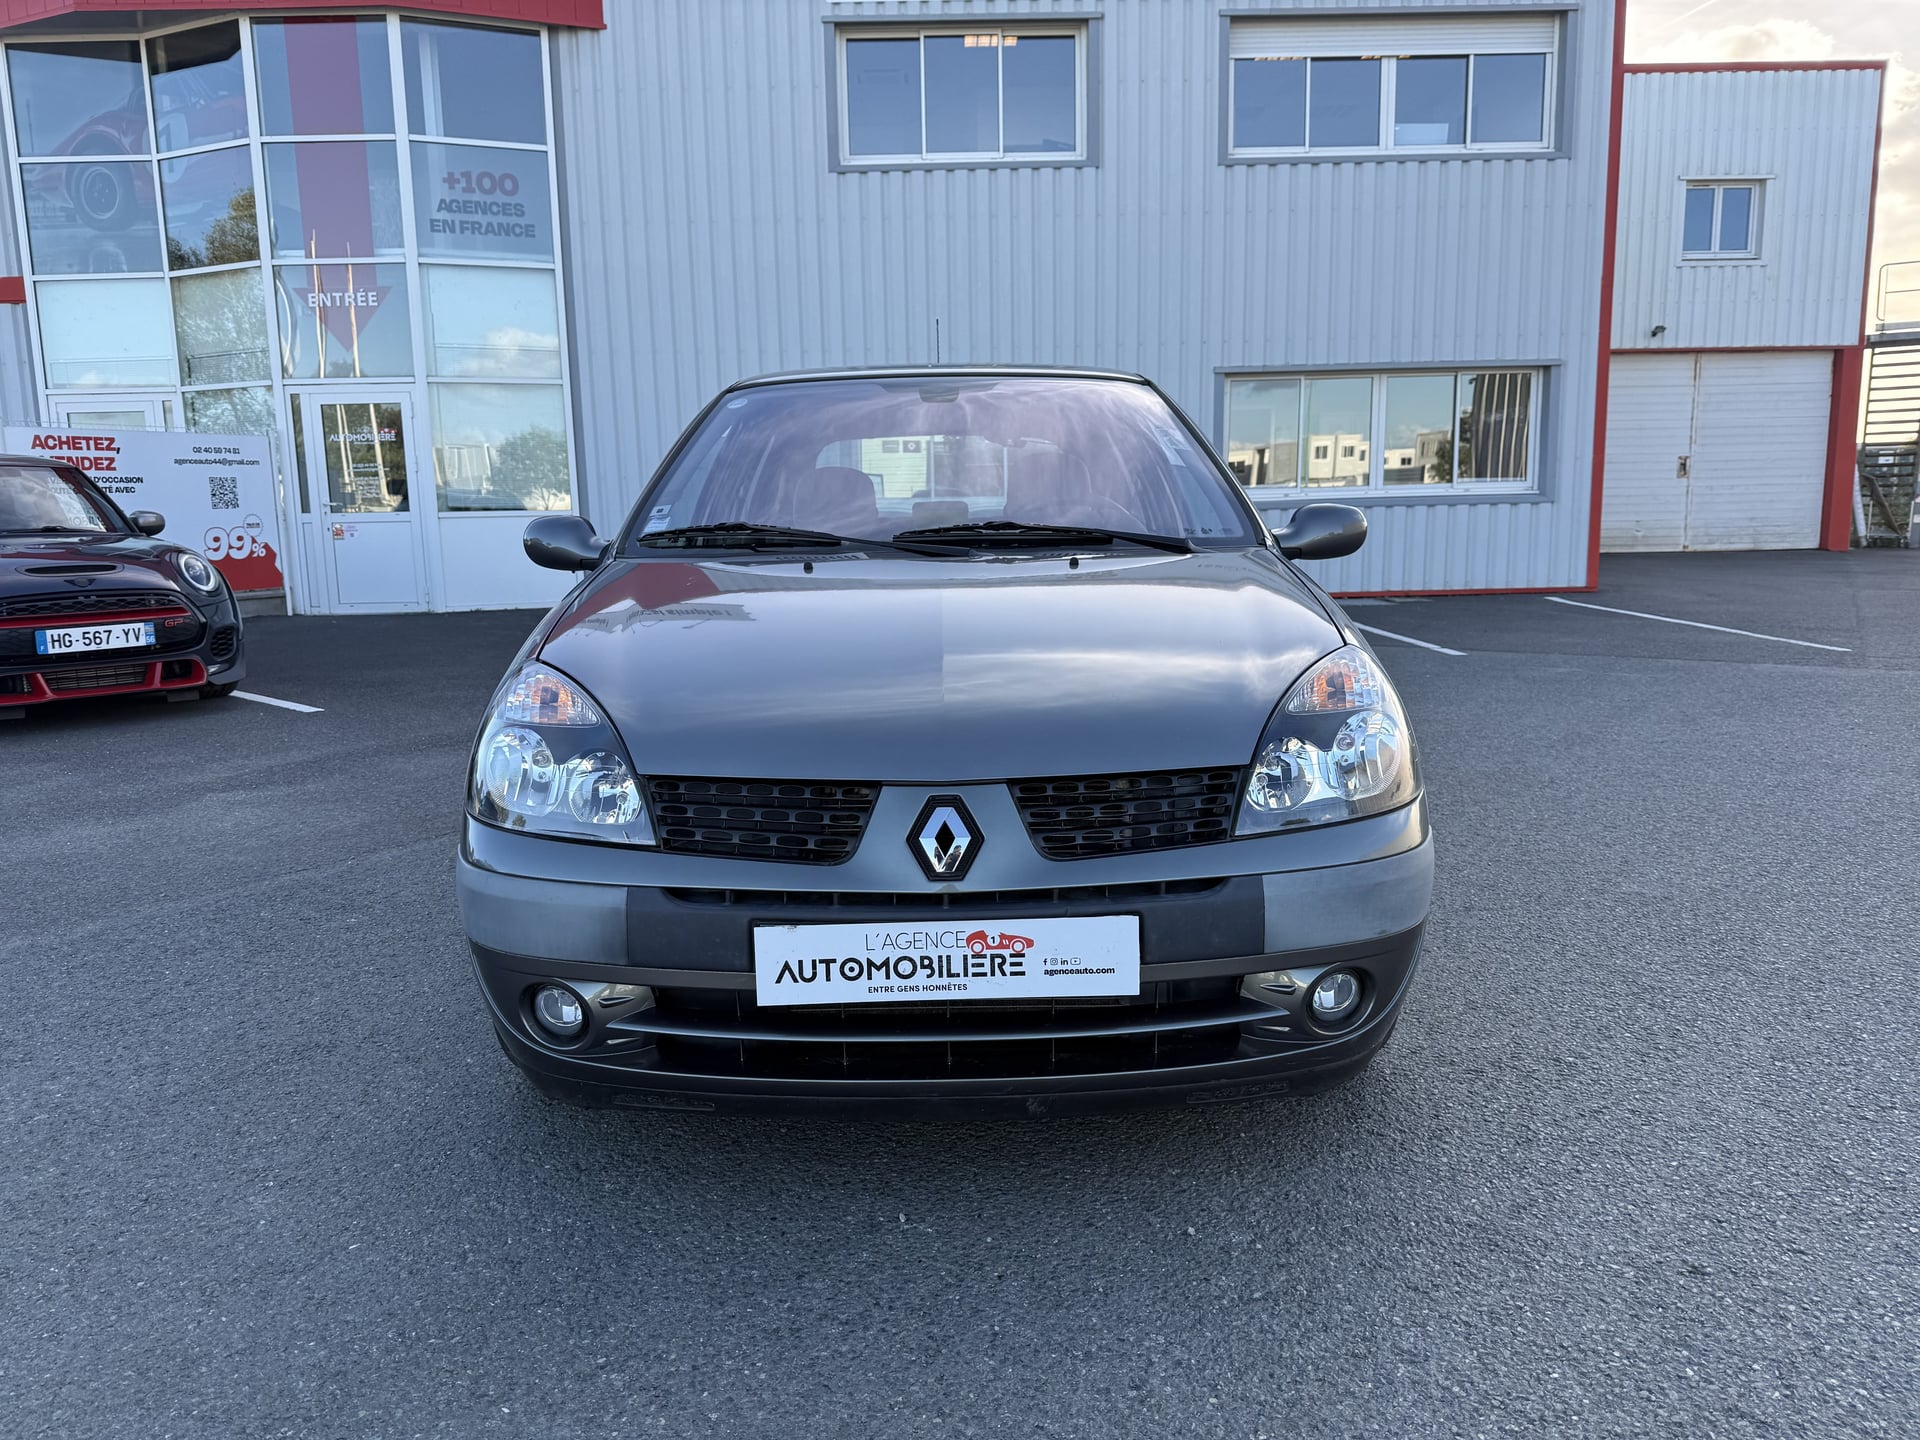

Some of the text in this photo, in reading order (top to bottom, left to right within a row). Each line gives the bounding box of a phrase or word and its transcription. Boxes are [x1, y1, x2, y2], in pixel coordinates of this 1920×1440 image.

[442, 170, 519, 197] +100
[436, 198, 526, 218] AGENCES
[429, 218, 536, 238] EN FRANCE
[307, 288, 378, 307] ENTRÉE
[31, 434, 121, 454] ACHETEZ,
[93, 476, 144, 484] D'OCCASION
[114, 486, 136, 494] AVEC
[164, 618, 184, 628] GP
[50, 627, 141, 650] HG-567-YV
[865, 930, 997, 951] L'AGENCE 1
[1043, 967, 1116, 977] agenceauto.com
[867, 981, 968, 994] ENTRE GENS HONNÊTES
